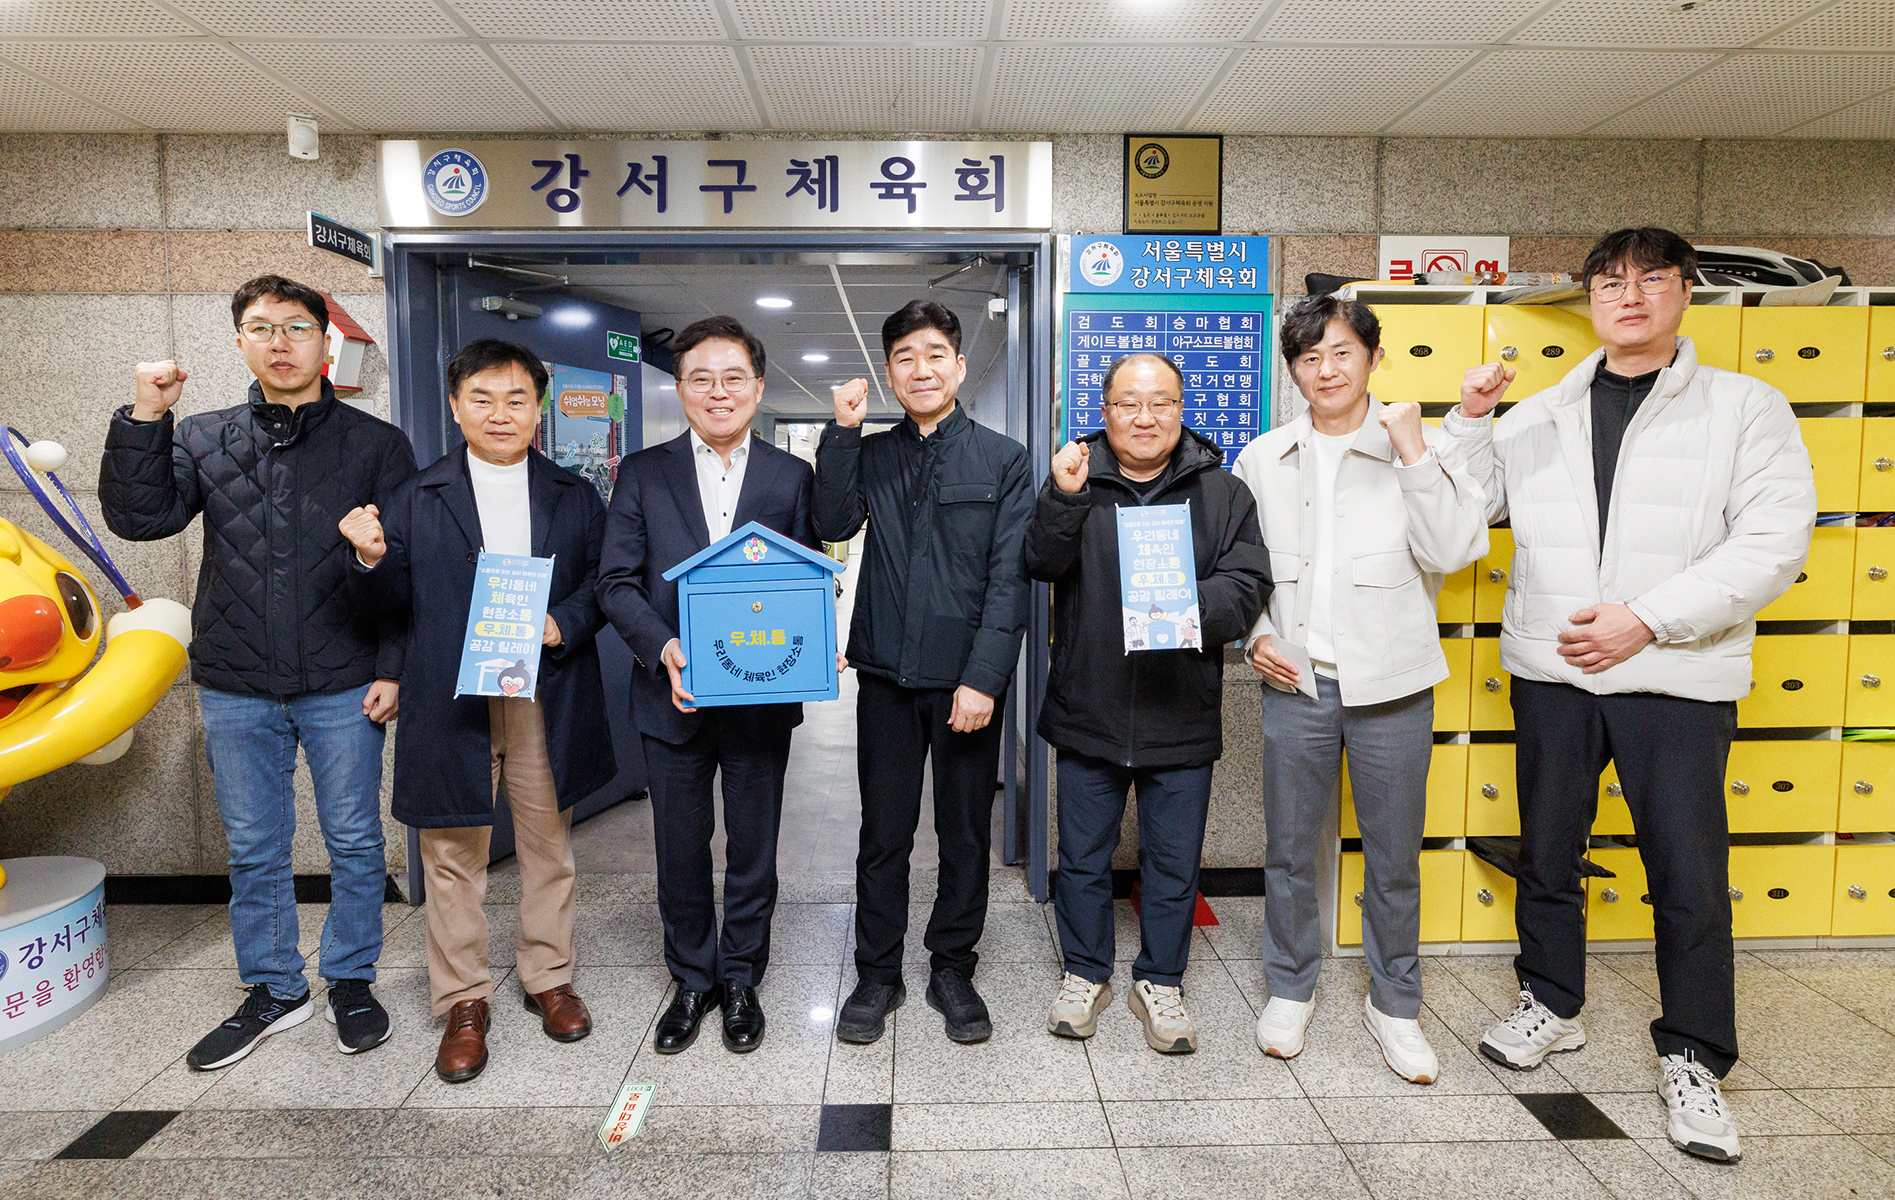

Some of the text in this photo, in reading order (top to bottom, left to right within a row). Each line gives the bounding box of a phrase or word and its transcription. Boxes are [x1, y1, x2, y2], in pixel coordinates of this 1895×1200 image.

[427, 153, 479, 176] 강서구체육회
[531, 154, 1006, 215] 강서구체육회
[427, 183, 482, 211] GANGSEO SPORTS COUNCIL
[315, 224, 371, 261] 강서구체육회
[1141, 240, 1247, 263] 서울특별시
[1130, 266, 1257, 289] 강서구체육회
[619, 340, 633, 348] AED
[1077, 335, 1157, 349] 게이트볼협회
[1172, 335, 1253, 349] 야구소프트볼협회
[1413, 347, 1429, 356] 268
[1545, 347, 1561, 356] 289
[1184, 374, 1252, 388] 전거연맹
[592, 396, 606, 408] 모닝
[1131, 529, 1179, 542] 우리동네
[1138, 543, 1174, 556] 체육인
[1133, 557, 1181, 571] 현장소통
[487, 577, 537, 592] 우리동네
[1138, 573, 1179, 585] 우.체.통
[490, 591, 529, 606] 체육인
[1127, 588, 1192, 602] 공감 릴레이
[482, 606, 533, 622] 현장소통
[483, 624, 527, 637] 우.체.통
[730, 629, 786, 647] 우.체.통
[470, 639, 535, 655] 공감 릴레이
[713, 639, 743, 678] 우리동네
[742, 670, 777, 683] 체육인
[608, 1092, 642, 1143] 비상대피로
